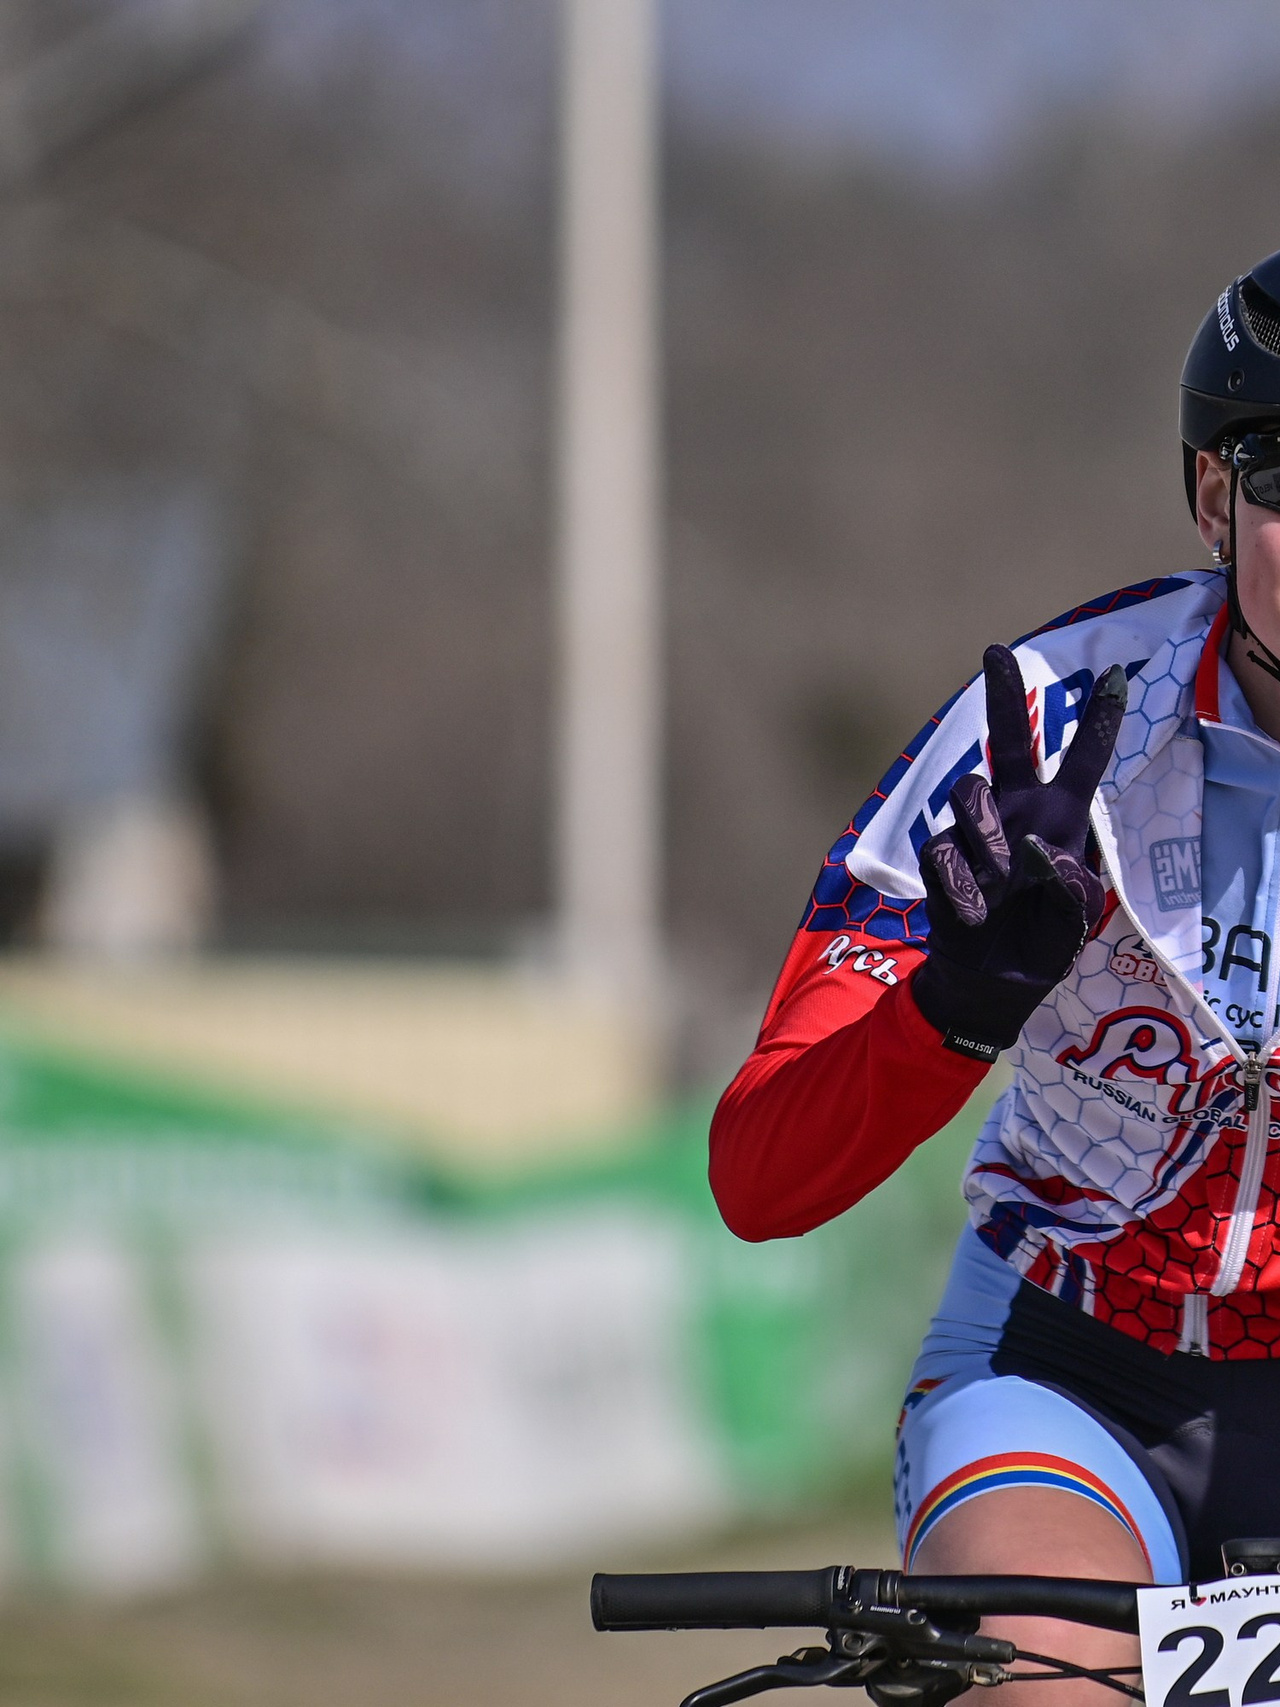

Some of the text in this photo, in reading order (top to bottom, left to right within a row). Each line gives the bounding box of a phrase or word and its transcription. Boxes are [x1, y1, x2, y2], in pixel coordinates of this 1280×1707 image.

[1072, 1070, 1156, 1123] RUSSIAN
[1162, 1108, 1248, 1130] GLOBAL
[1170, 1598, 1187, 1611] Я
